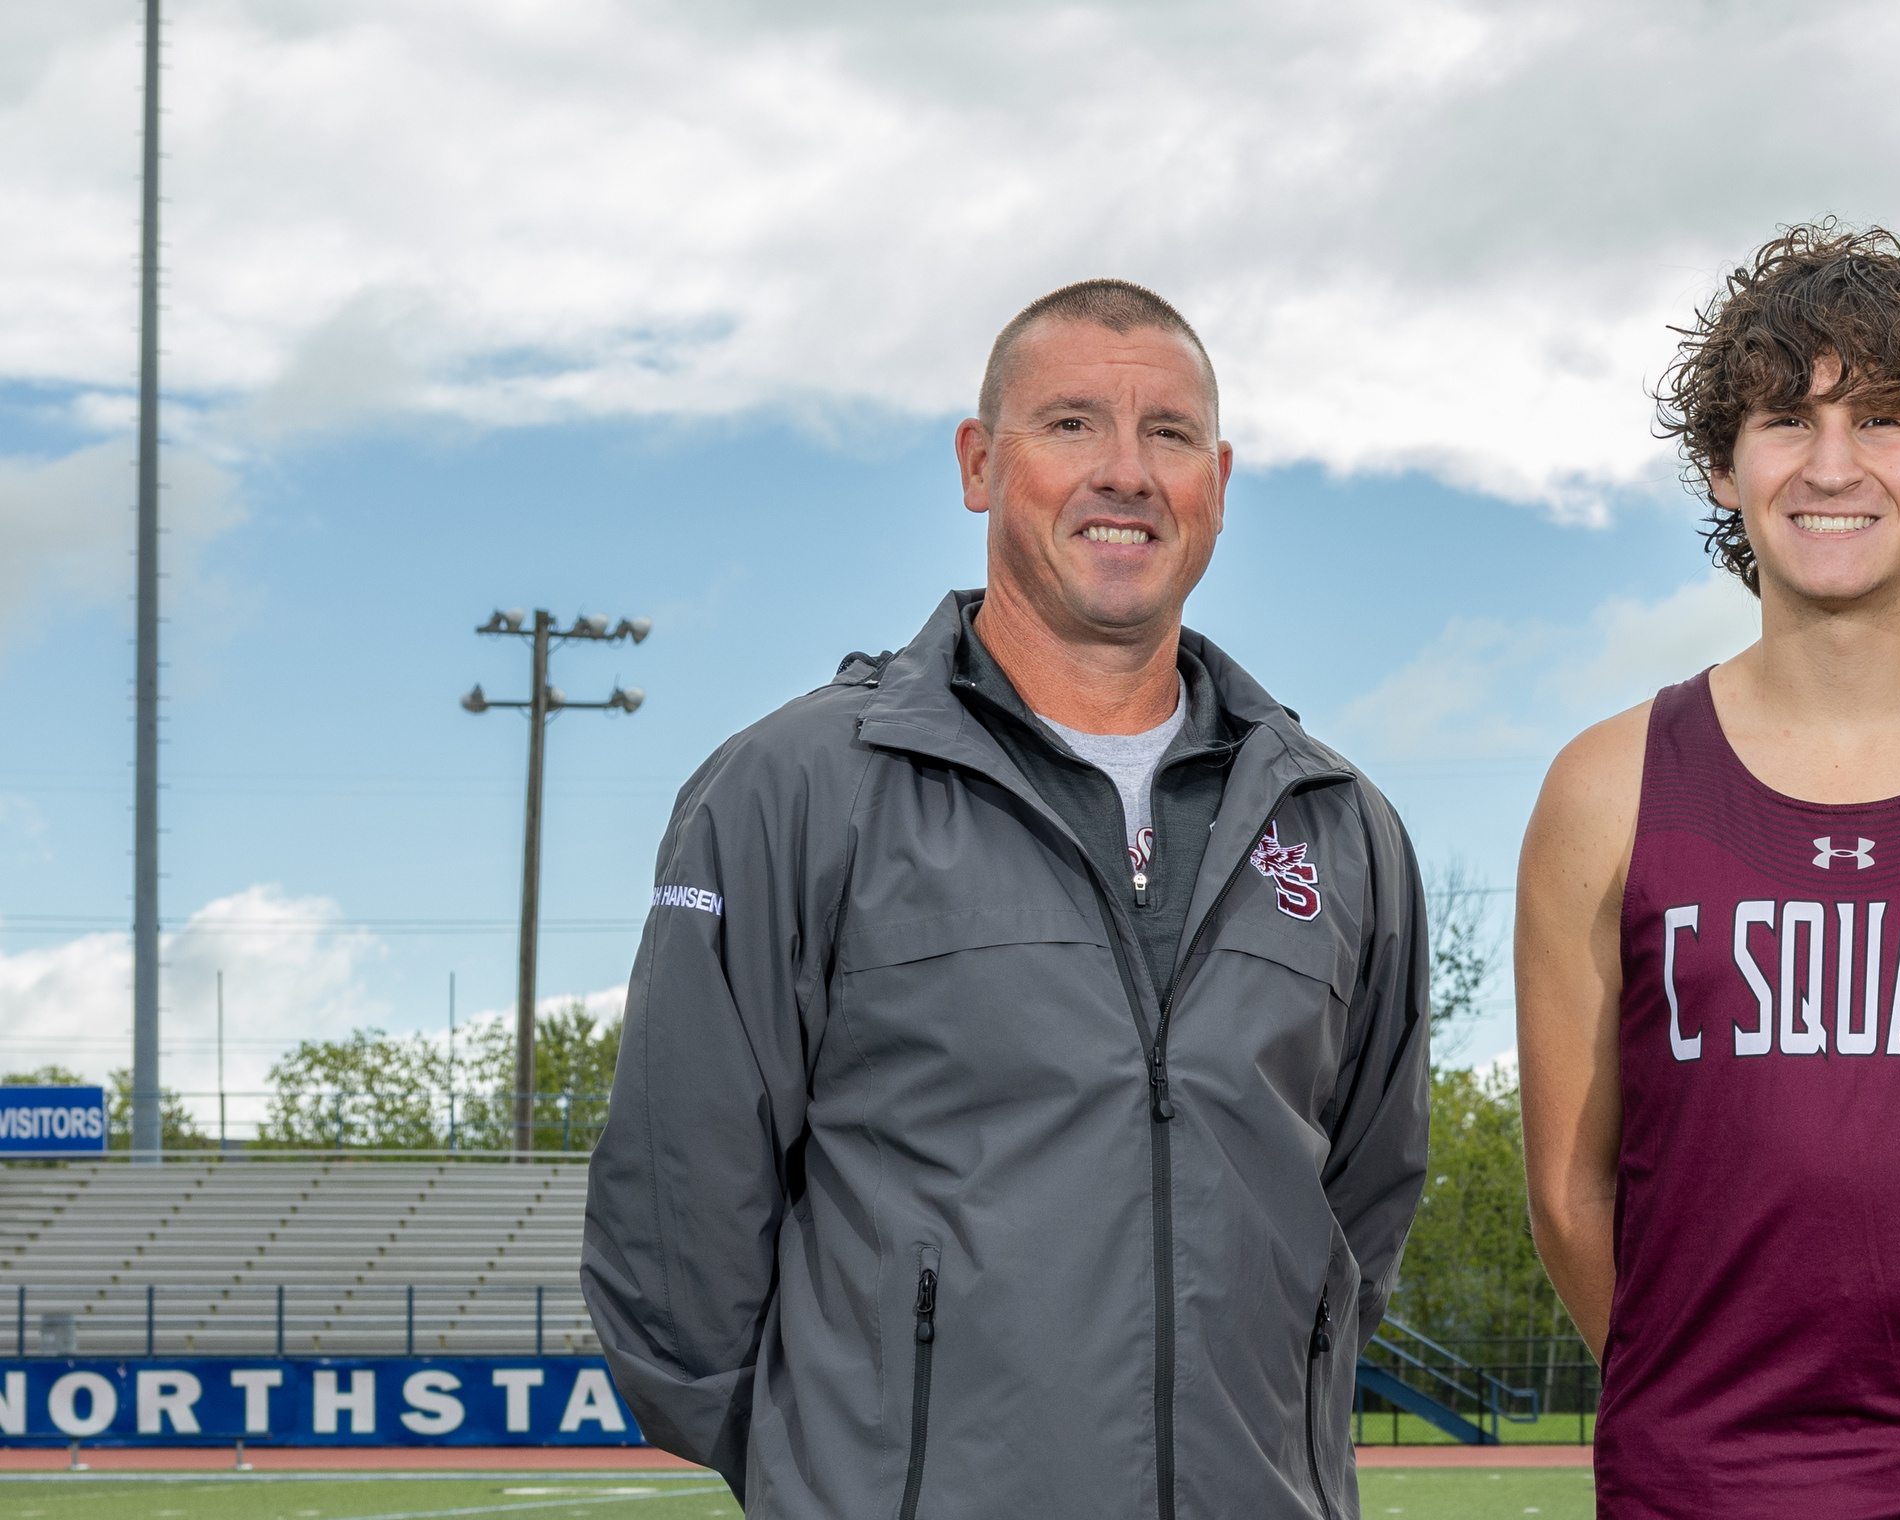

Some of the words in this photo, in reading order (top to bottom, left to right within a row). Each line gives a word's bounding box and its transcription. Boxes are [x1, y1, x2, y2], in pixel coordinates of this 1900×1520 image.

[661, 885, 723, 916] HANSEN
[1664, 904, 1702, 1061] C
[0, 1107, 102, 1139] VISITORS
